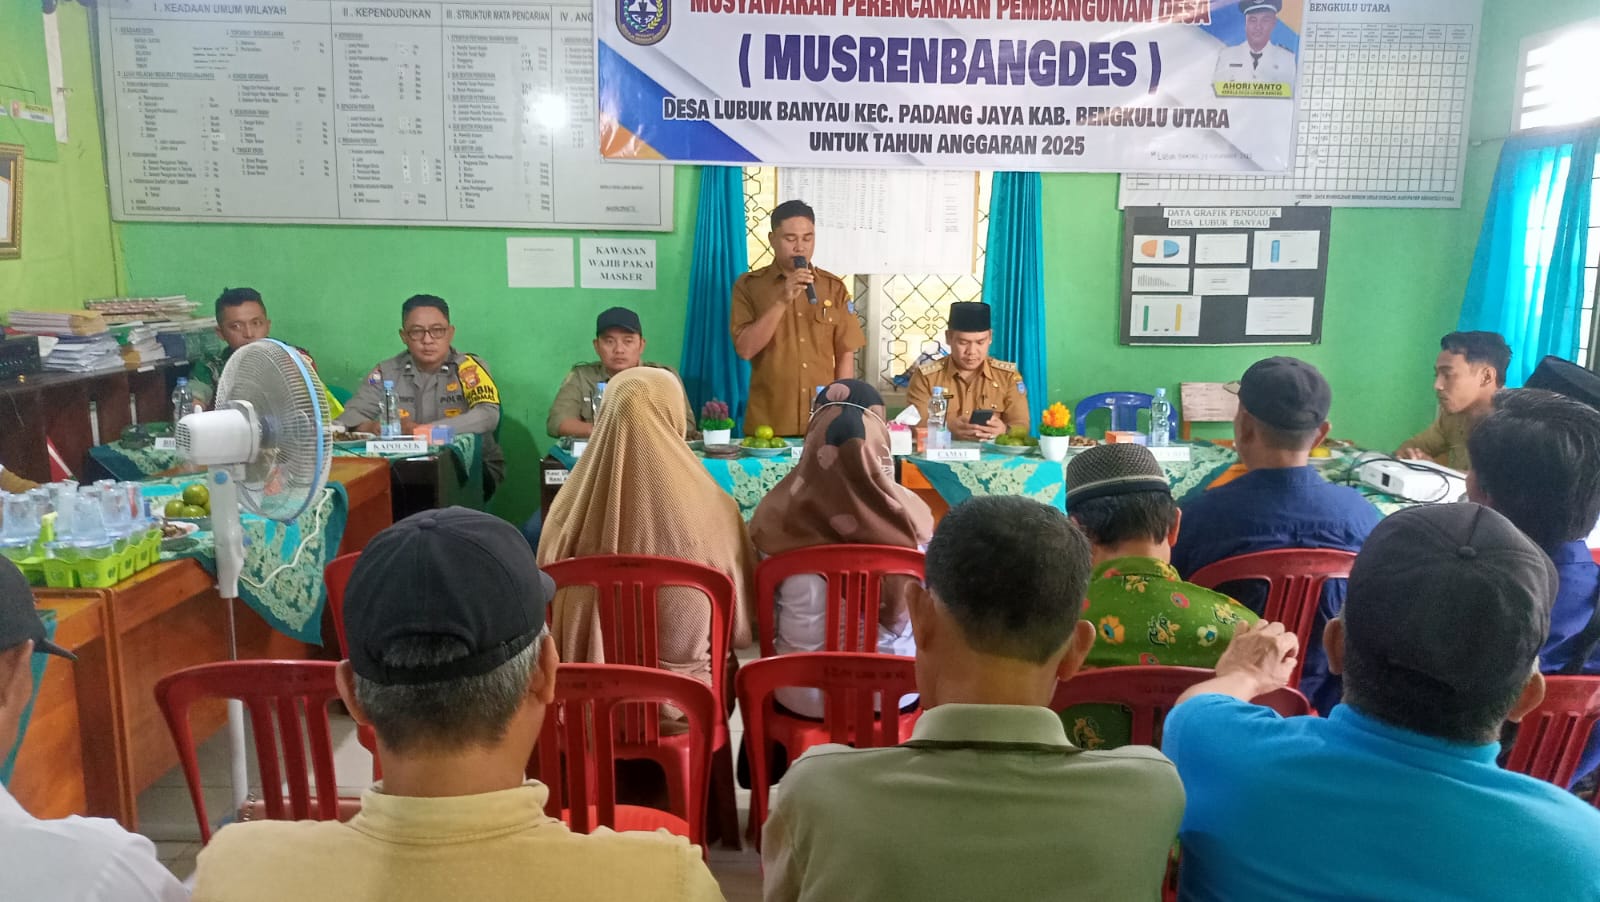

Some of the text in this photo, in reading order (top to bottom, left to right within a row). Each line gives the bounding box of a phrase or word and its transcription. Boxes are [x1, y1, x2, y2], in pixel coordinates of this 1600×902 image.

[164, 4, 211, 14] KEADAAN
[214, 4, 243, 15] UMUM
[244, 5, 287, 16] WILAYAH
[842, 0, 990, 19] PERENCANAAN
[996, 0, 1153, 23] PEMBANGUNAN
[1158, 0, 1210, 24] DESA
[1309, 3, 1390, 13] BENGKULU UTARA
[355, 8, 431, 19] KEPENDUDUKAN
[456, 11, 492, 20] STRUKTUR
[493, 11, 511, 21] MATA
[512, 11, 550, 21] PENCARIAN
[764, 34, 1137, 87] MUSRENBANGDES
[1222, 82, 1282, 91] AHORI YANTO
[664, 98, 1229, 129] DESA LUBUK BANYAU KEC. PADANG JAYA KAB. BENGKULU UTARA
[809, 131, 1085, 156] UNTUK TAHUN ANGGARAN 2025
[1167, 209, 1277, 217] DATA GRAFIK PENDUDUK
[1170, 218, 1268, 227] DESA LUBUK BANYAU
[596, 246, 646, 255] KAWASAN
[588, 259, 653, 268] WAJIB PAKAI
[601, 272, 642, 281] MASKER
